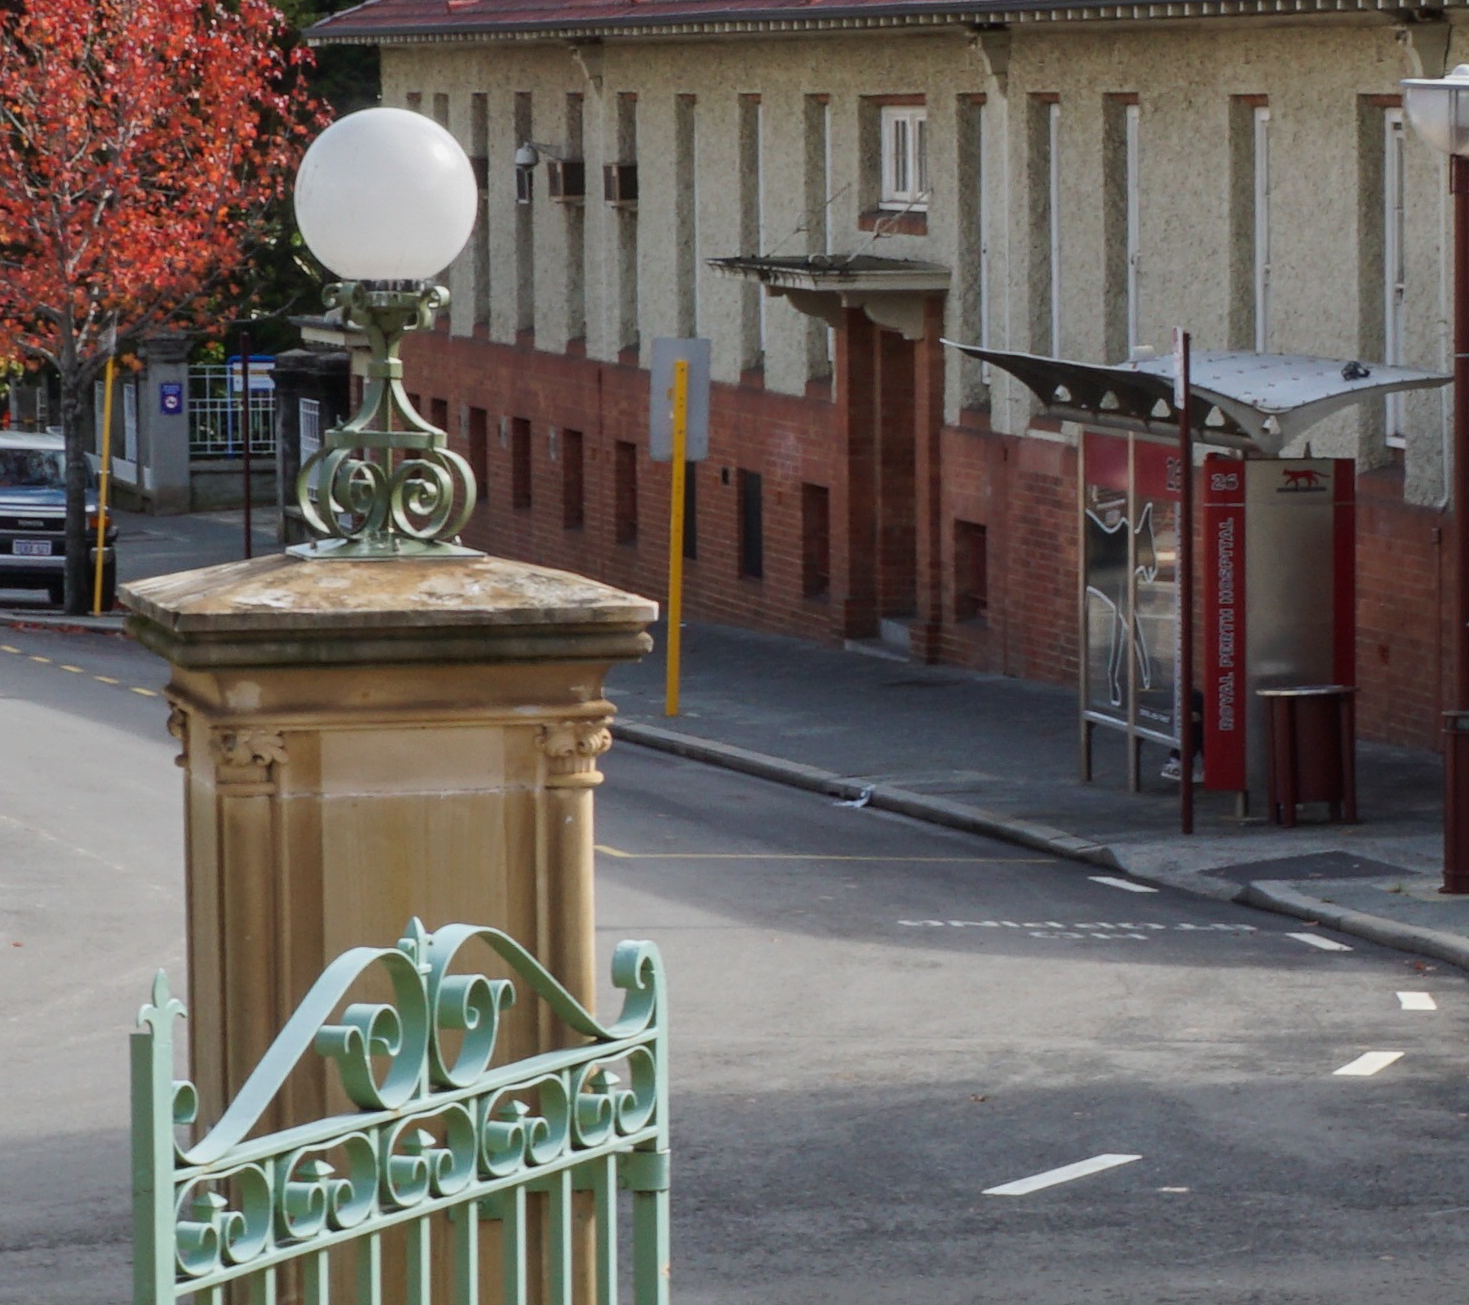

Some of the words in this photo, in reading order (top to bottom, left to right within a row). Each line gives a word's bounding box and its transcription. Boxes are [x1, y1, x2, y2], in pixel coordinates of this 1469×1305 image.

[1211, 473, 1238, 491] 26
[1219, 517, 1235, 605] HOSPITAL
[1219, 609, 1235, 667] PERTH
[1219, 671, 1235, 731] ROYAL
